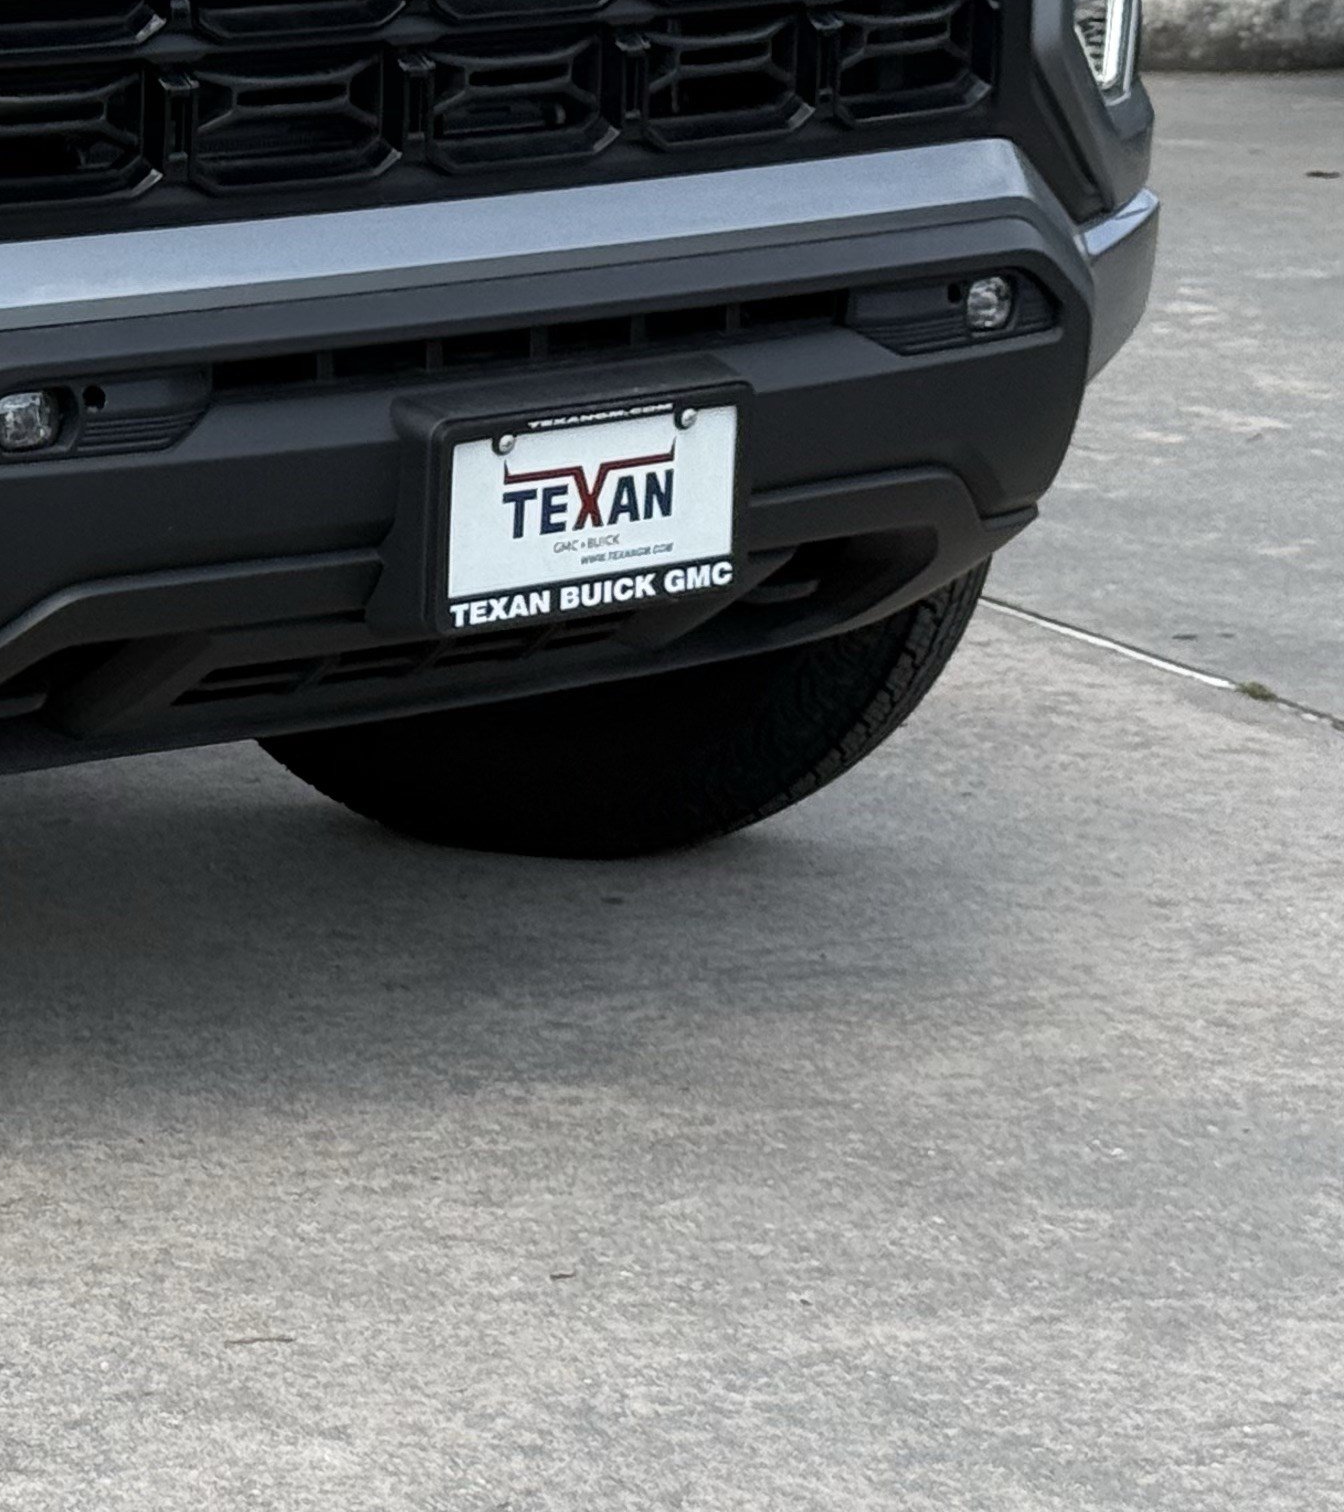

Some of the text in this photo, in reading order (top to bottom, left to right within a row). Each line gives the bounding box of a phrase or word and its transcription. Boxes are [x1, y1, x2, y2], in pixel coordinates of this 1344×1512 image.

[502, 460, 675, 539] TEXAN
[450, 561, 733, 628] TEXAN BUICK GMC
